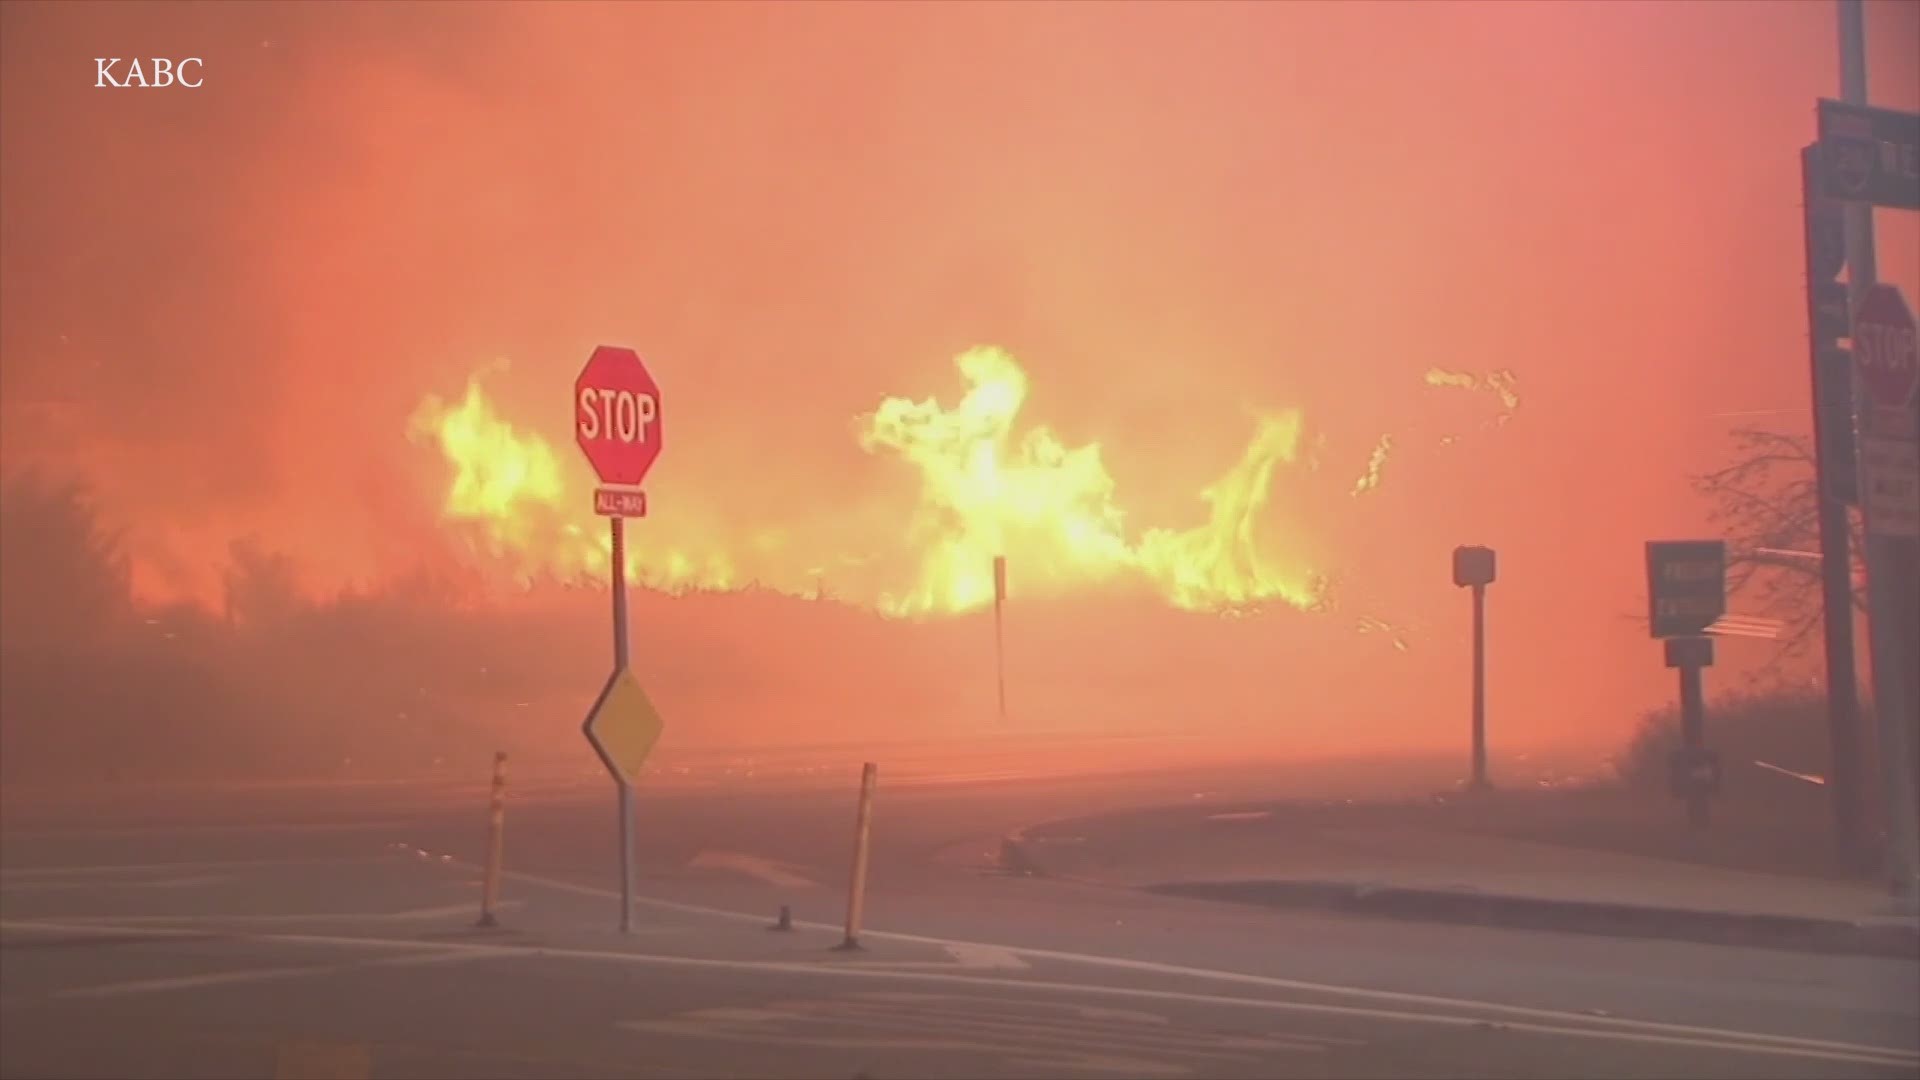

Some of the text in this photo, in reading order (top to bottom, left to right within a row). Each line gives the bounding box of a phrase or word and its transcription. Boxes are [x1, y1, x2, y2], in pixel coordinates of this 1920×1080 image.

[1856, 322, 1914, 369] STOP
[579, 387, 656, 444] STOP
[597, 493, 643, 513] ALL-WAY
